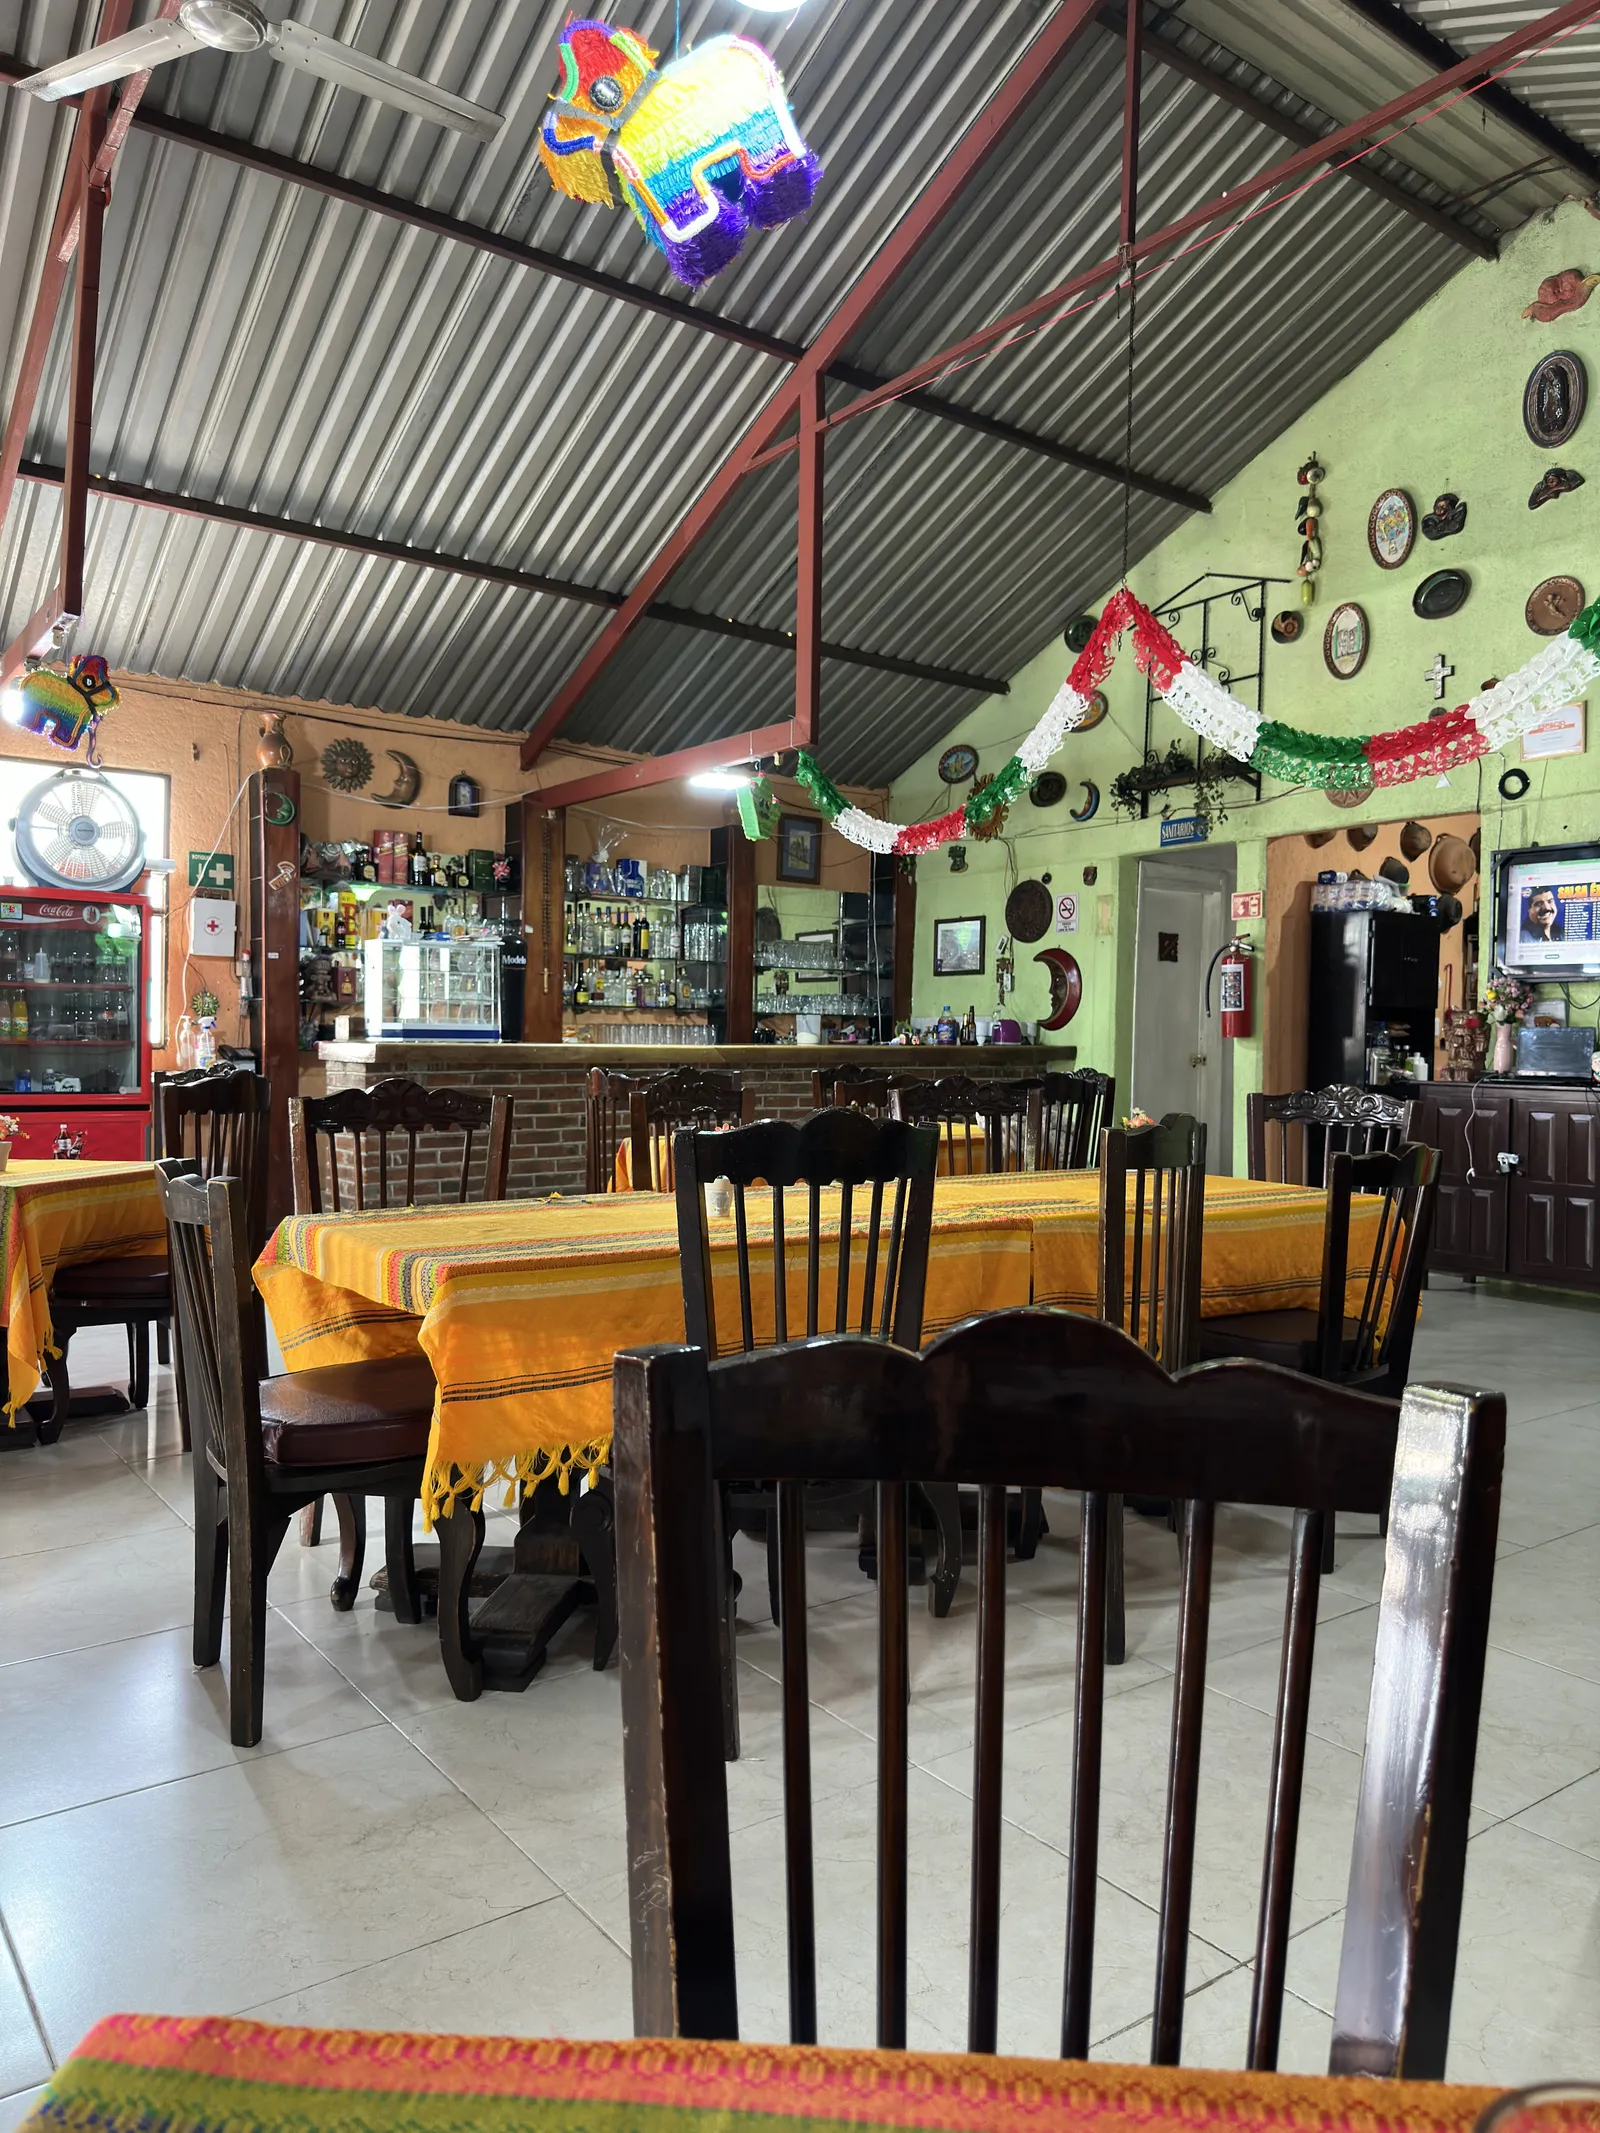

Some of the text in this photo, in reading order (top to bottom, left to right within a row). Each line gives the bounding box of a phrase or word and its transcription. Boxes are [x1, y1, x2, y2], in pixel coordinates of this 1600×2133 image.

[1162, 821, 1195, 839] SANITARIOS
[1558, 885, 1588, 899] SALSA
[39, 904, 75, 917] Coca-Cola
[502, 954, 527, 965] Modelo
